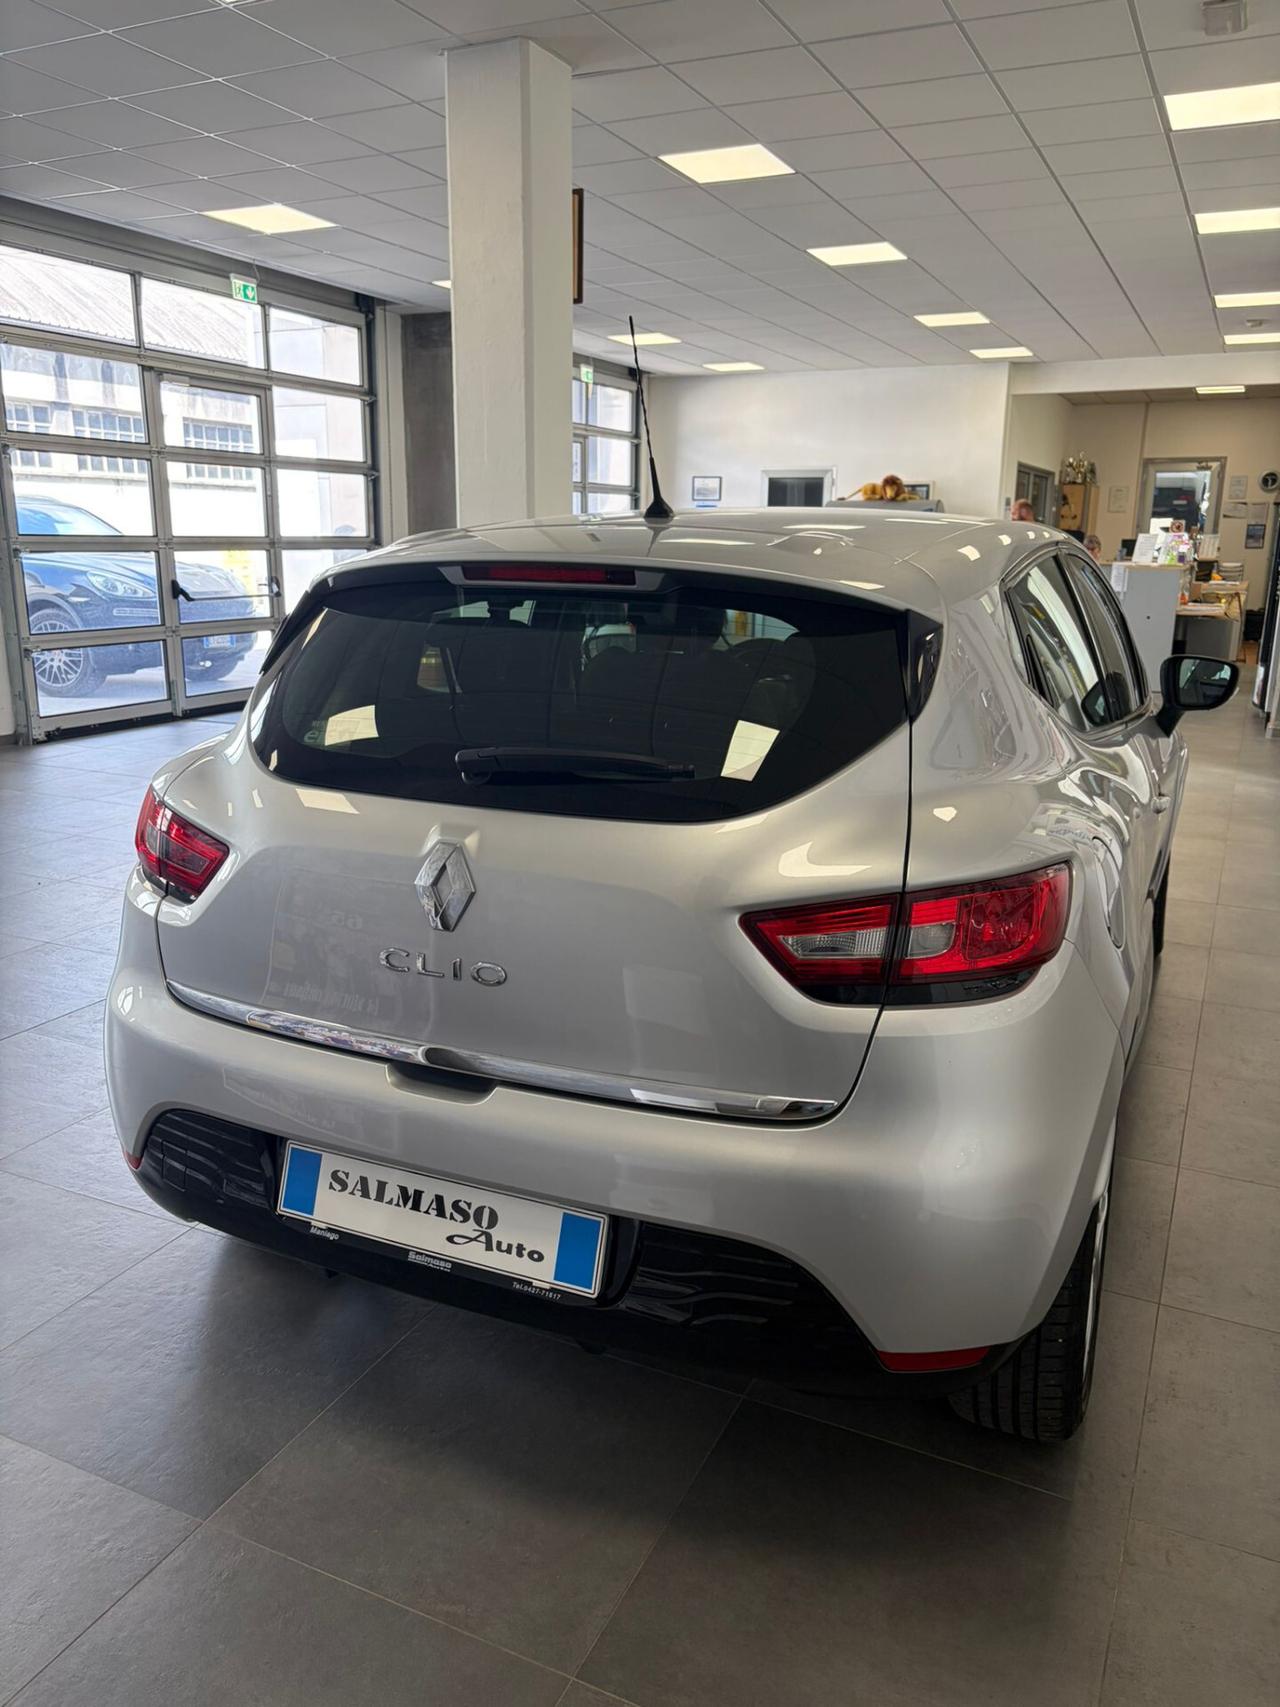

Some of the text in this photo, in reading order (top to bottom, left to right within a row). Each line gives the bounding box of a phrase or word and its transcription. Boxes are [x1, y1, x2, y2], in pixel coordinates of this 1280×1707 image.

[379, 947, 508, 987] CLIO
[328, 1169, 499, 1230] SALMASO
[310, 1226, 340, 1240] Maniago
[446, 1229, 545, 1263] Auto
[408, 1251, 452, 1269] Salmaso
